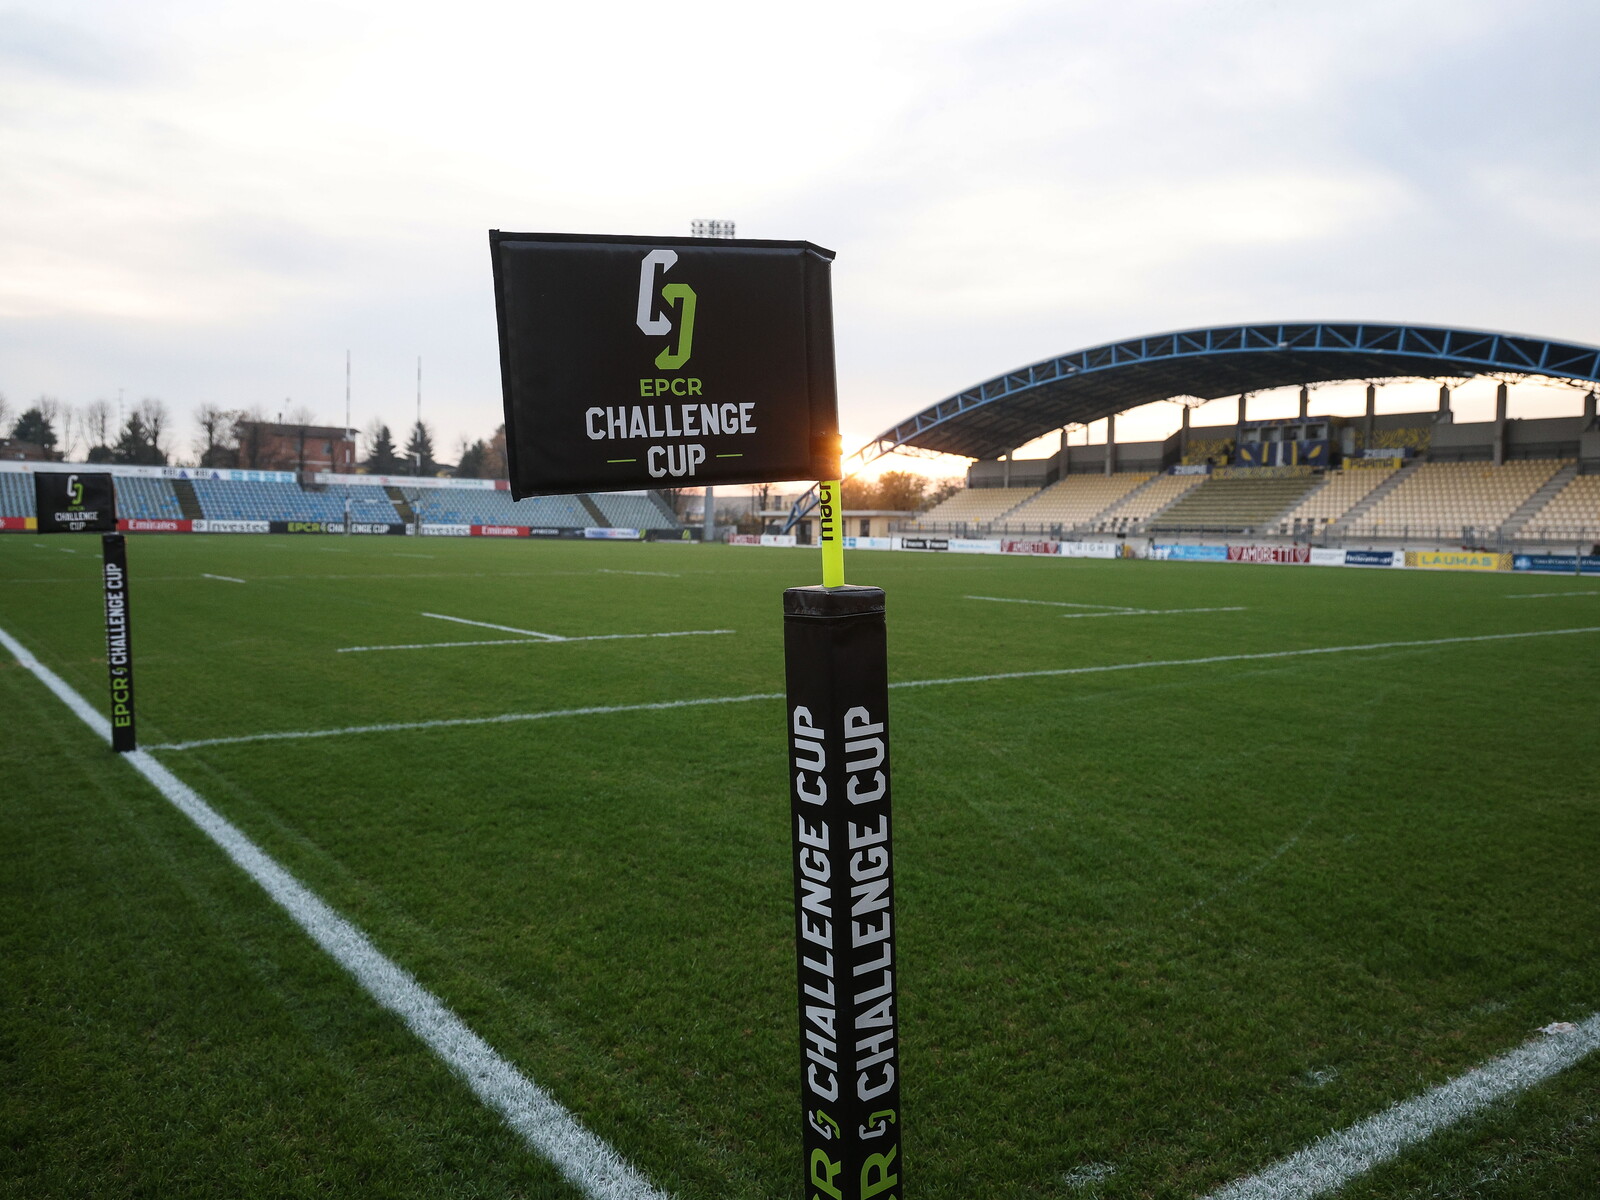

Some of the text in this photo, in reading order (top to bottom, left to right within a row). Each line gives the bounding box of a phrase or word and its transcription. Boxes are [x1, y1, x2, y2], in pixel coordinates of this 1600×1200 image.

[639, 378, 702, 396] EPCR
[585, 402, 757, 440] CHALLENGE
[647, 444, 706, 478] CUP
[55, 511, 98, 521] CHALLENGE
[69, 522, 86, 530] CUP
[128, 520, 178, 531] Emirates
[287, 522, 320, 532] EPCR
[373, 524, 390, 533] CUP
[481, 525, 519, 536] Emirates
[1242, 547, 1294, 562] AMORETTI
[1421, 555, 1493, 566] LAUMAS
[106, 563, 131, 727] EPCR CHALLENGE CUP
[793, 705, 828, 806] CUP
[844, 705, 887, 806] CUP
[798, 814, 838, 1103] CHALLENGE
[848, 814, 895, 1102] CHALLENGE
